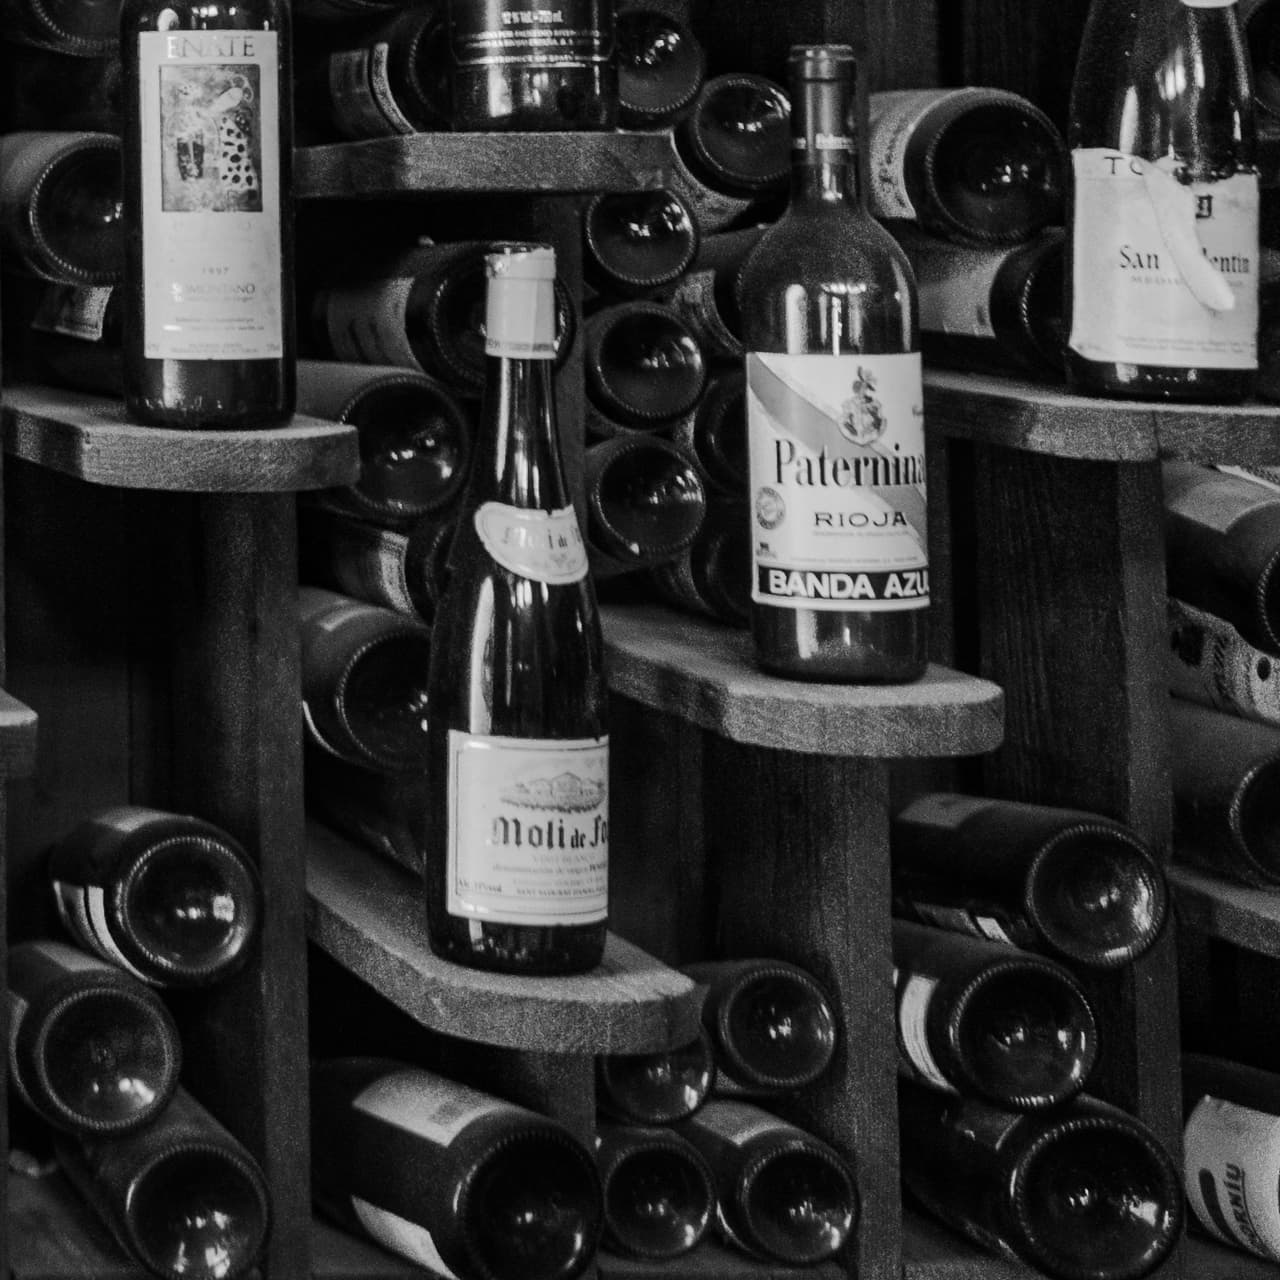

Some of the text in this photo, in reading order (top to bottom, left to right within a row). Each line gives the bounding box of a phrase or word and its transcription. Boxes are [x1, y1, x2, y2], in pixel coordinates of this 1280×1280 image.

[1119, 245, 1160, 270] San
[813, 511, 908, 528] RIOJA
[768, 570, 879, 599] BANDA
[491, 815, 586, 850] Moli de
